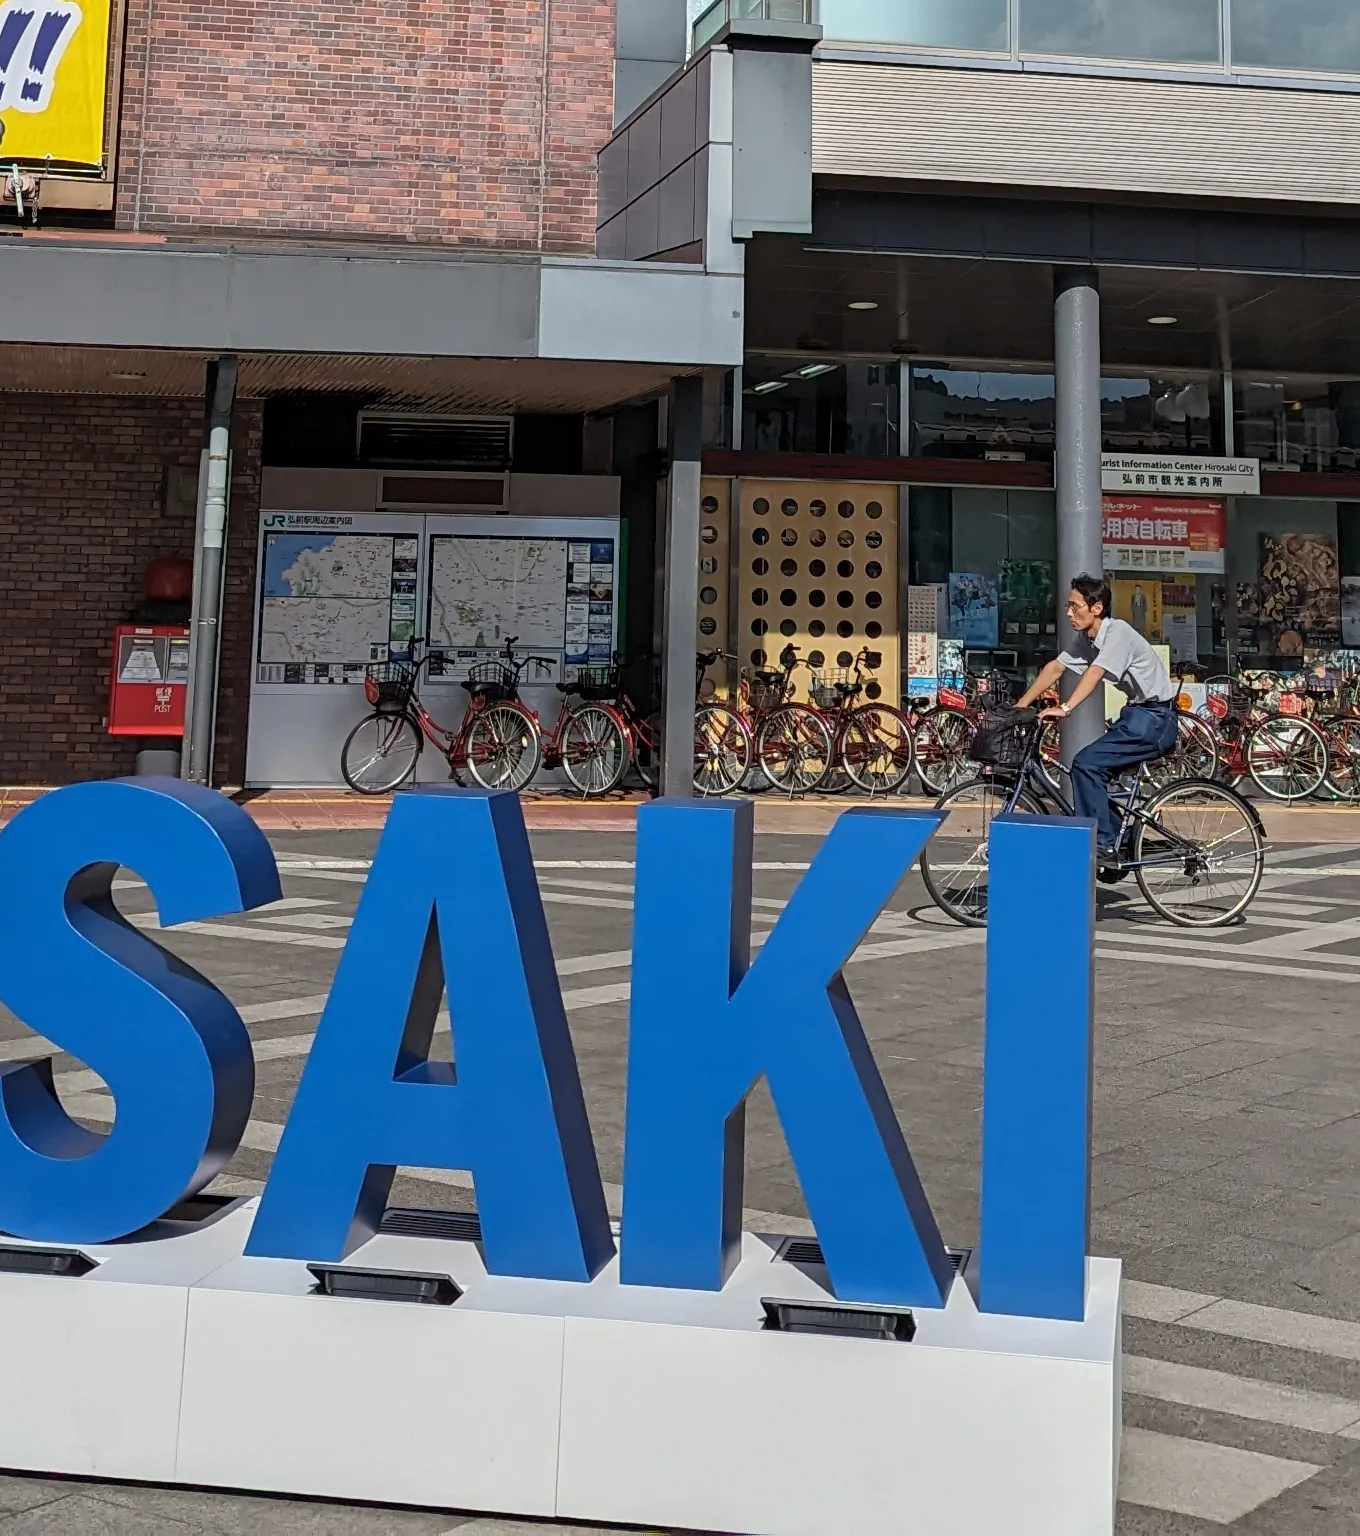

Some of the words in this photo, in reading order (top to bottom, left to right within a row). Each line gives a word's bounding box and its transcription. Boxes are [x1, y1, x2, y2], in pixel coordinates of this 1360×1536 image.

[1122, 459, 1173, 470] Information
[1174, 461, 1203, 471] Center
[1204, 462, 1237, 473] Hirosaki
[1238, 464, 1255, 475] City
[1122, 473, 1223, 488] 弘前市観光案内所
[263, 514, 286, 527] JR
[1102, 517, 1189, 541] 用貸自転車
[154, 704, 172, 713] POST
